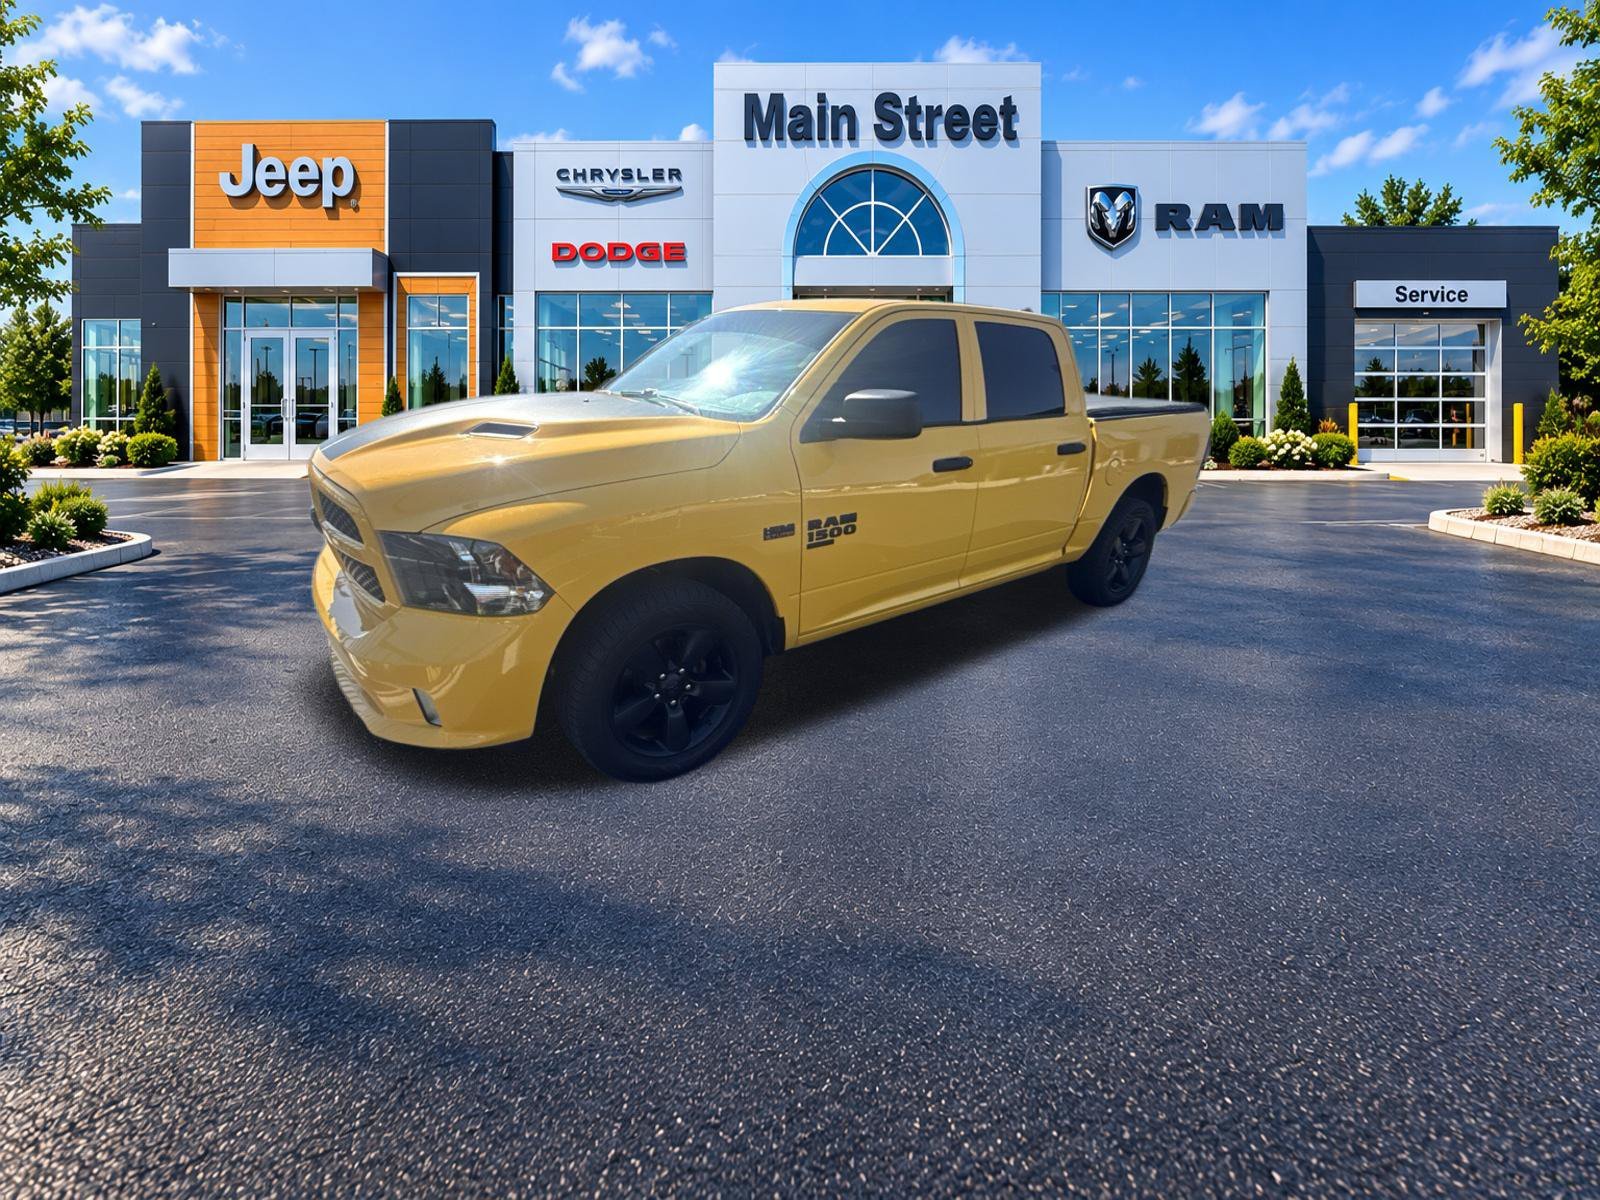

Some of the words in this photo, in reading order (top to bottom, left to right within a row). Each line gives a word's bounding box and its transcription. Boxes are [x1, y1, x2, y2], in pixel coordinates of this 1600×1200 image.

[744, 92, 856, 141] Main
[873, 91, 1017, 141] Street
[218, 143, 355, 209] Jeep
[556, 168, 683, 182] CHRYSLER
[1155, 203, 1284, 231] RAM
[551, 242, 687, 262] DODGE
[1395, 285, 1469, 303] Service
[807, 523, 857, 542] 1500
